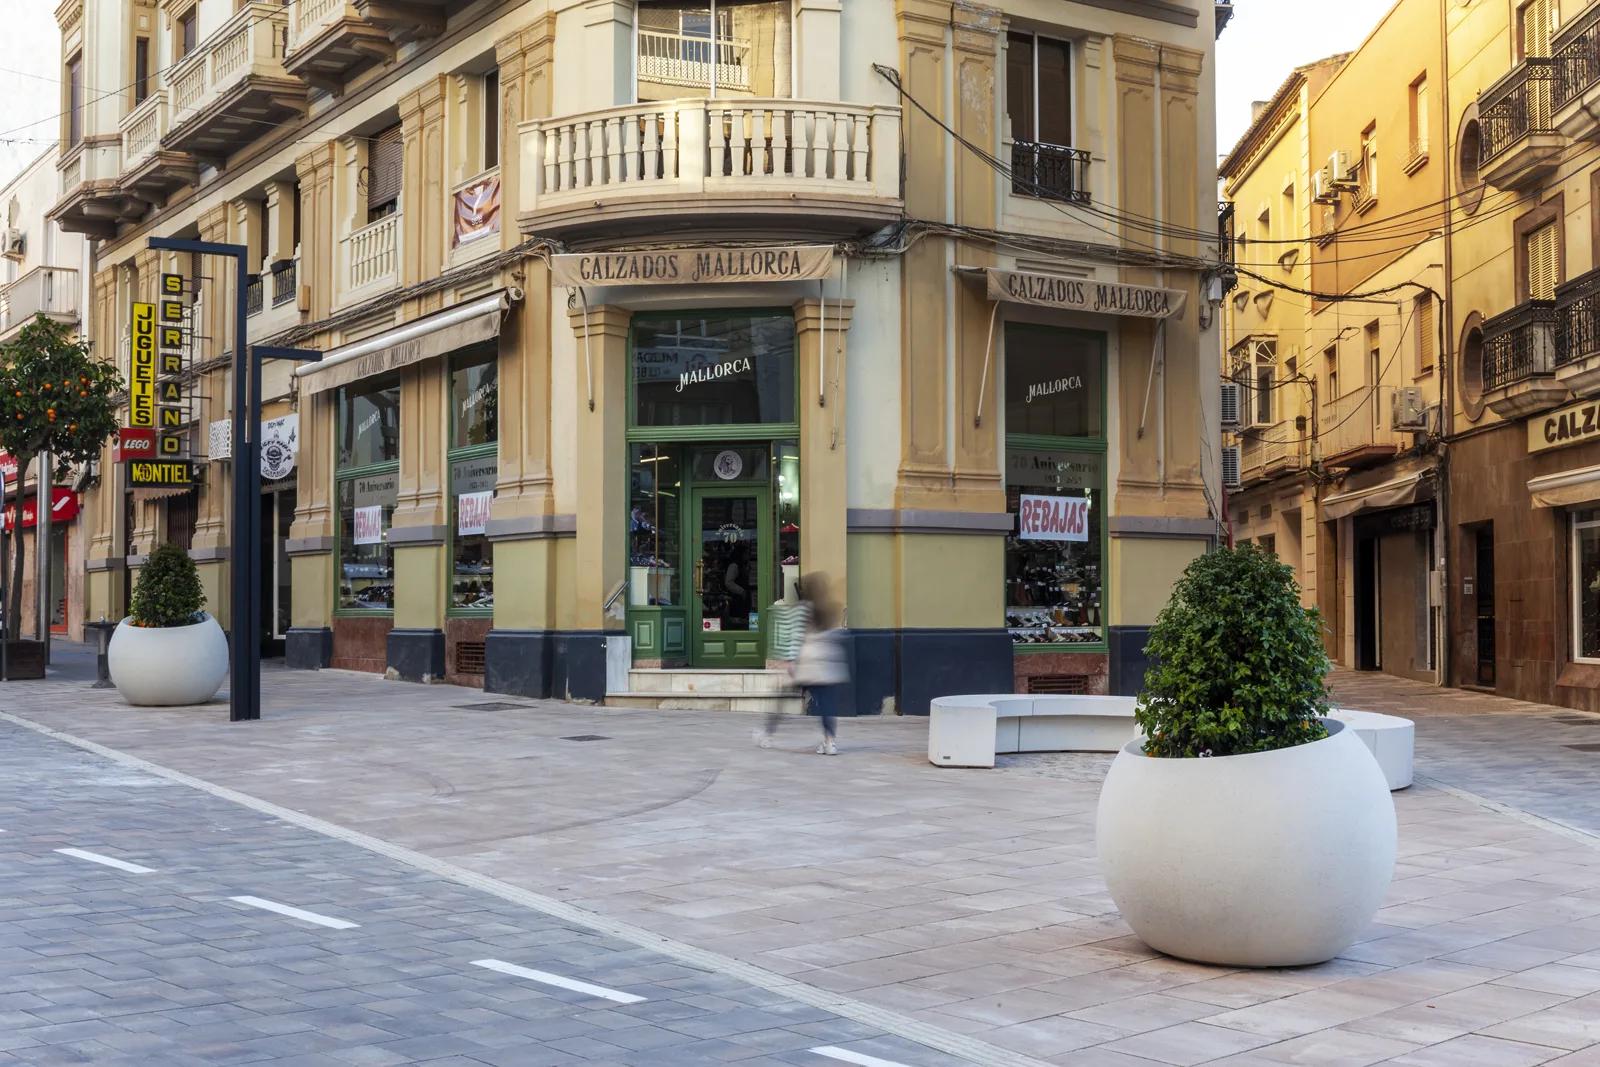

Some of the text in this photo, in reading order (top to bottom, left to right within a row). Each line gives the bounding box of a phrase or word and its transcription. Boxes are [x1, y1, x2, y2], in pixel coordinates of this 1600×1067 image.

[580, 250, 801, 282] CALZADOS MALLORCA
[1008, 273, 1170, 313] CALZADOS MALLORCA
[136, 305, 153, 424] JUGUETES
[164, 276, 181, 453] SERRANO
[391, 339, 421, 368] MALLORCA
[675, 357, 751, 393] MALLORCA
[1025, 376, 1082, 403] MALLORCA
[461, 382, 491, 418] MALLORCA
[1544, 404, 1600, 443] CALZ
[124, 439, 150, 449] LEGO
[132, 463, 192, 483] MONTIEL
[355, 510, 381, 539] REBAJAS
[460, 495, 494, 529] REBAJAS
[1021, 499, 1087, 534] REBAJAS
